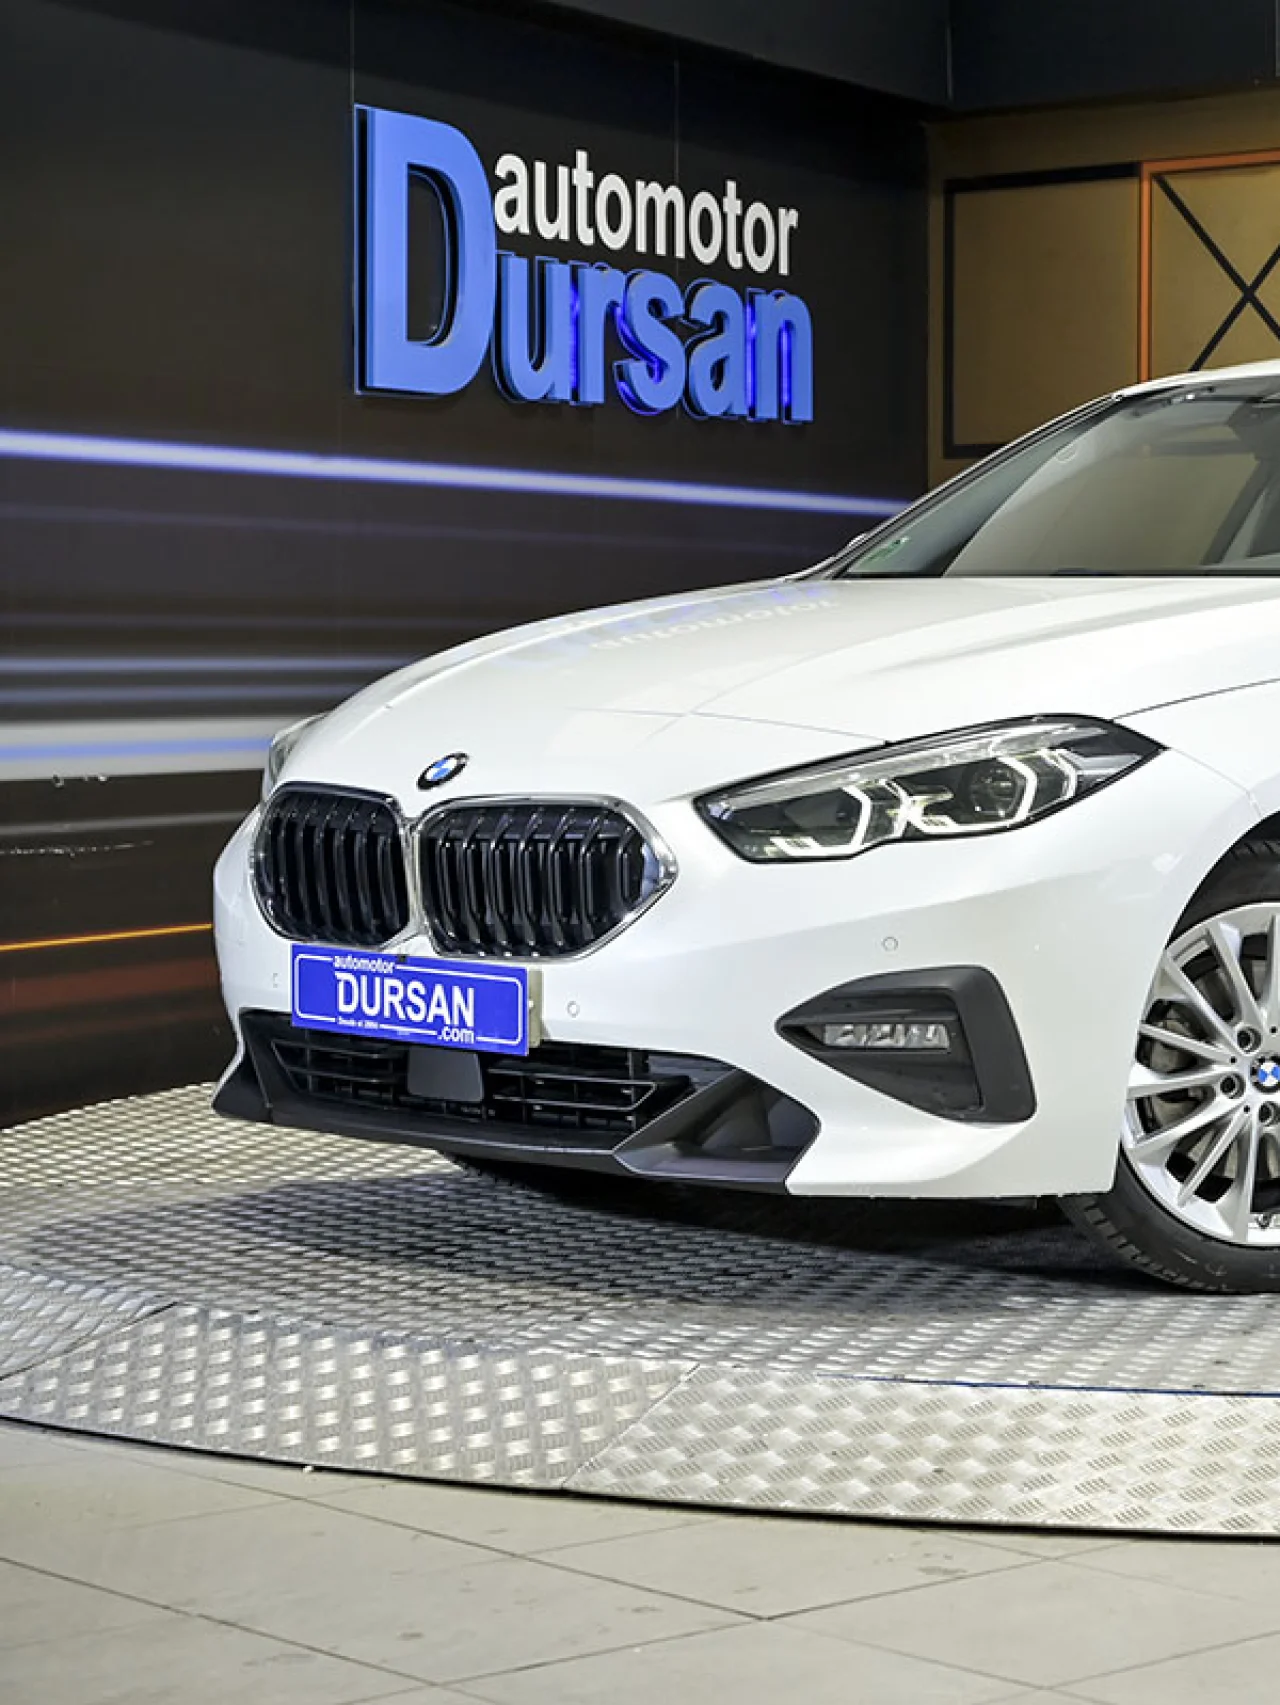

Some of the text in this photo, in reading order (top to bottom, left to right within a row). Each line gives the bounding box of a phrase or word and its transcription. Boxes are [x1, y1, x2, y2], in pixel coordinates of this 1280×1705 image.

[494, 148, 798, 276] automotor
[354, 103, 813, 424] Dursan
[333, 955, 395, 974] automotor
[334, 971, 475, 1028] DURSAN
[437, 1026, 475, 1044] .com
